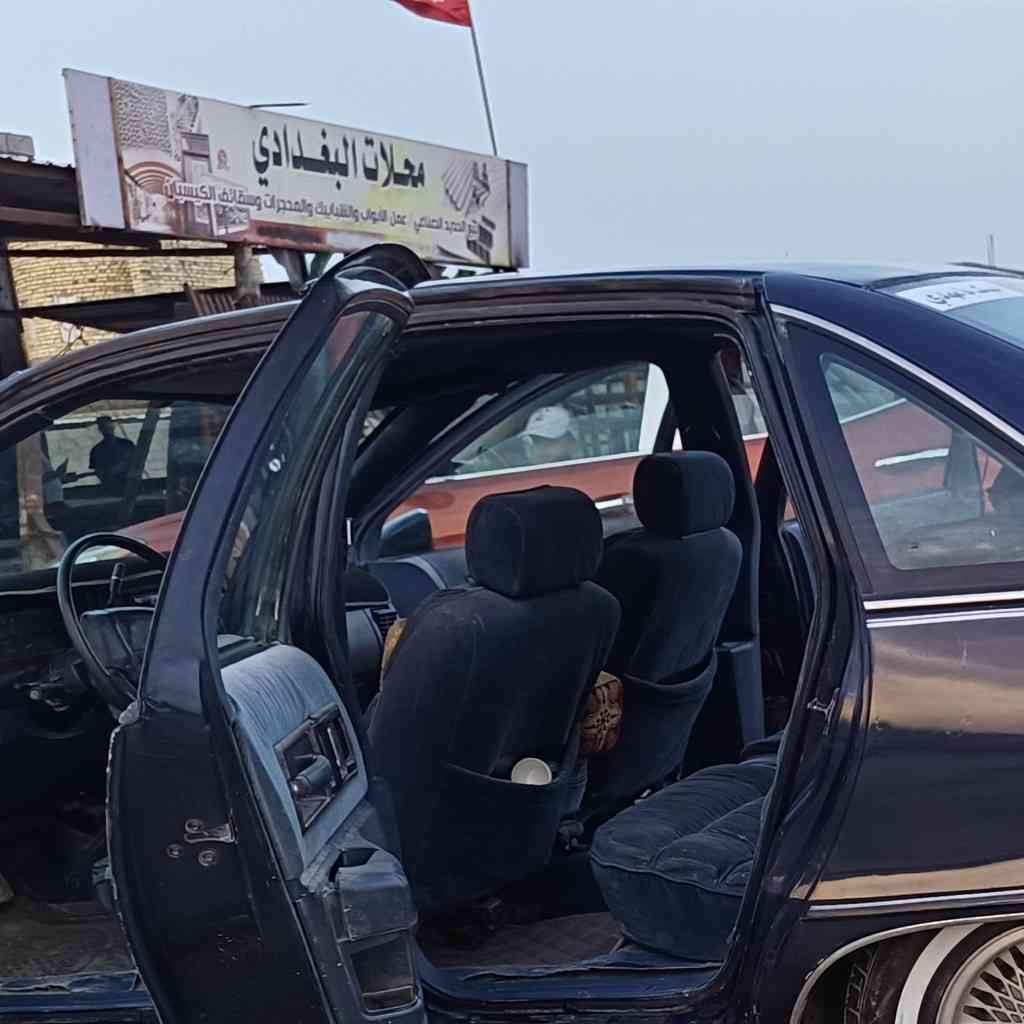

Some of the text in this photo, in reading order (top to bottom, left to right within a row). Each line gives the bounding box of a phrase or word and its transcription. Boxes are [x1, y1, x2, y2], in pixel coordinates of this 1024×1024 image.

[252, 123, 425, 191] محلات البغدادي
[263, 193, 313, 217] والمحجرات
[390, 210, 407, 227] عمل
